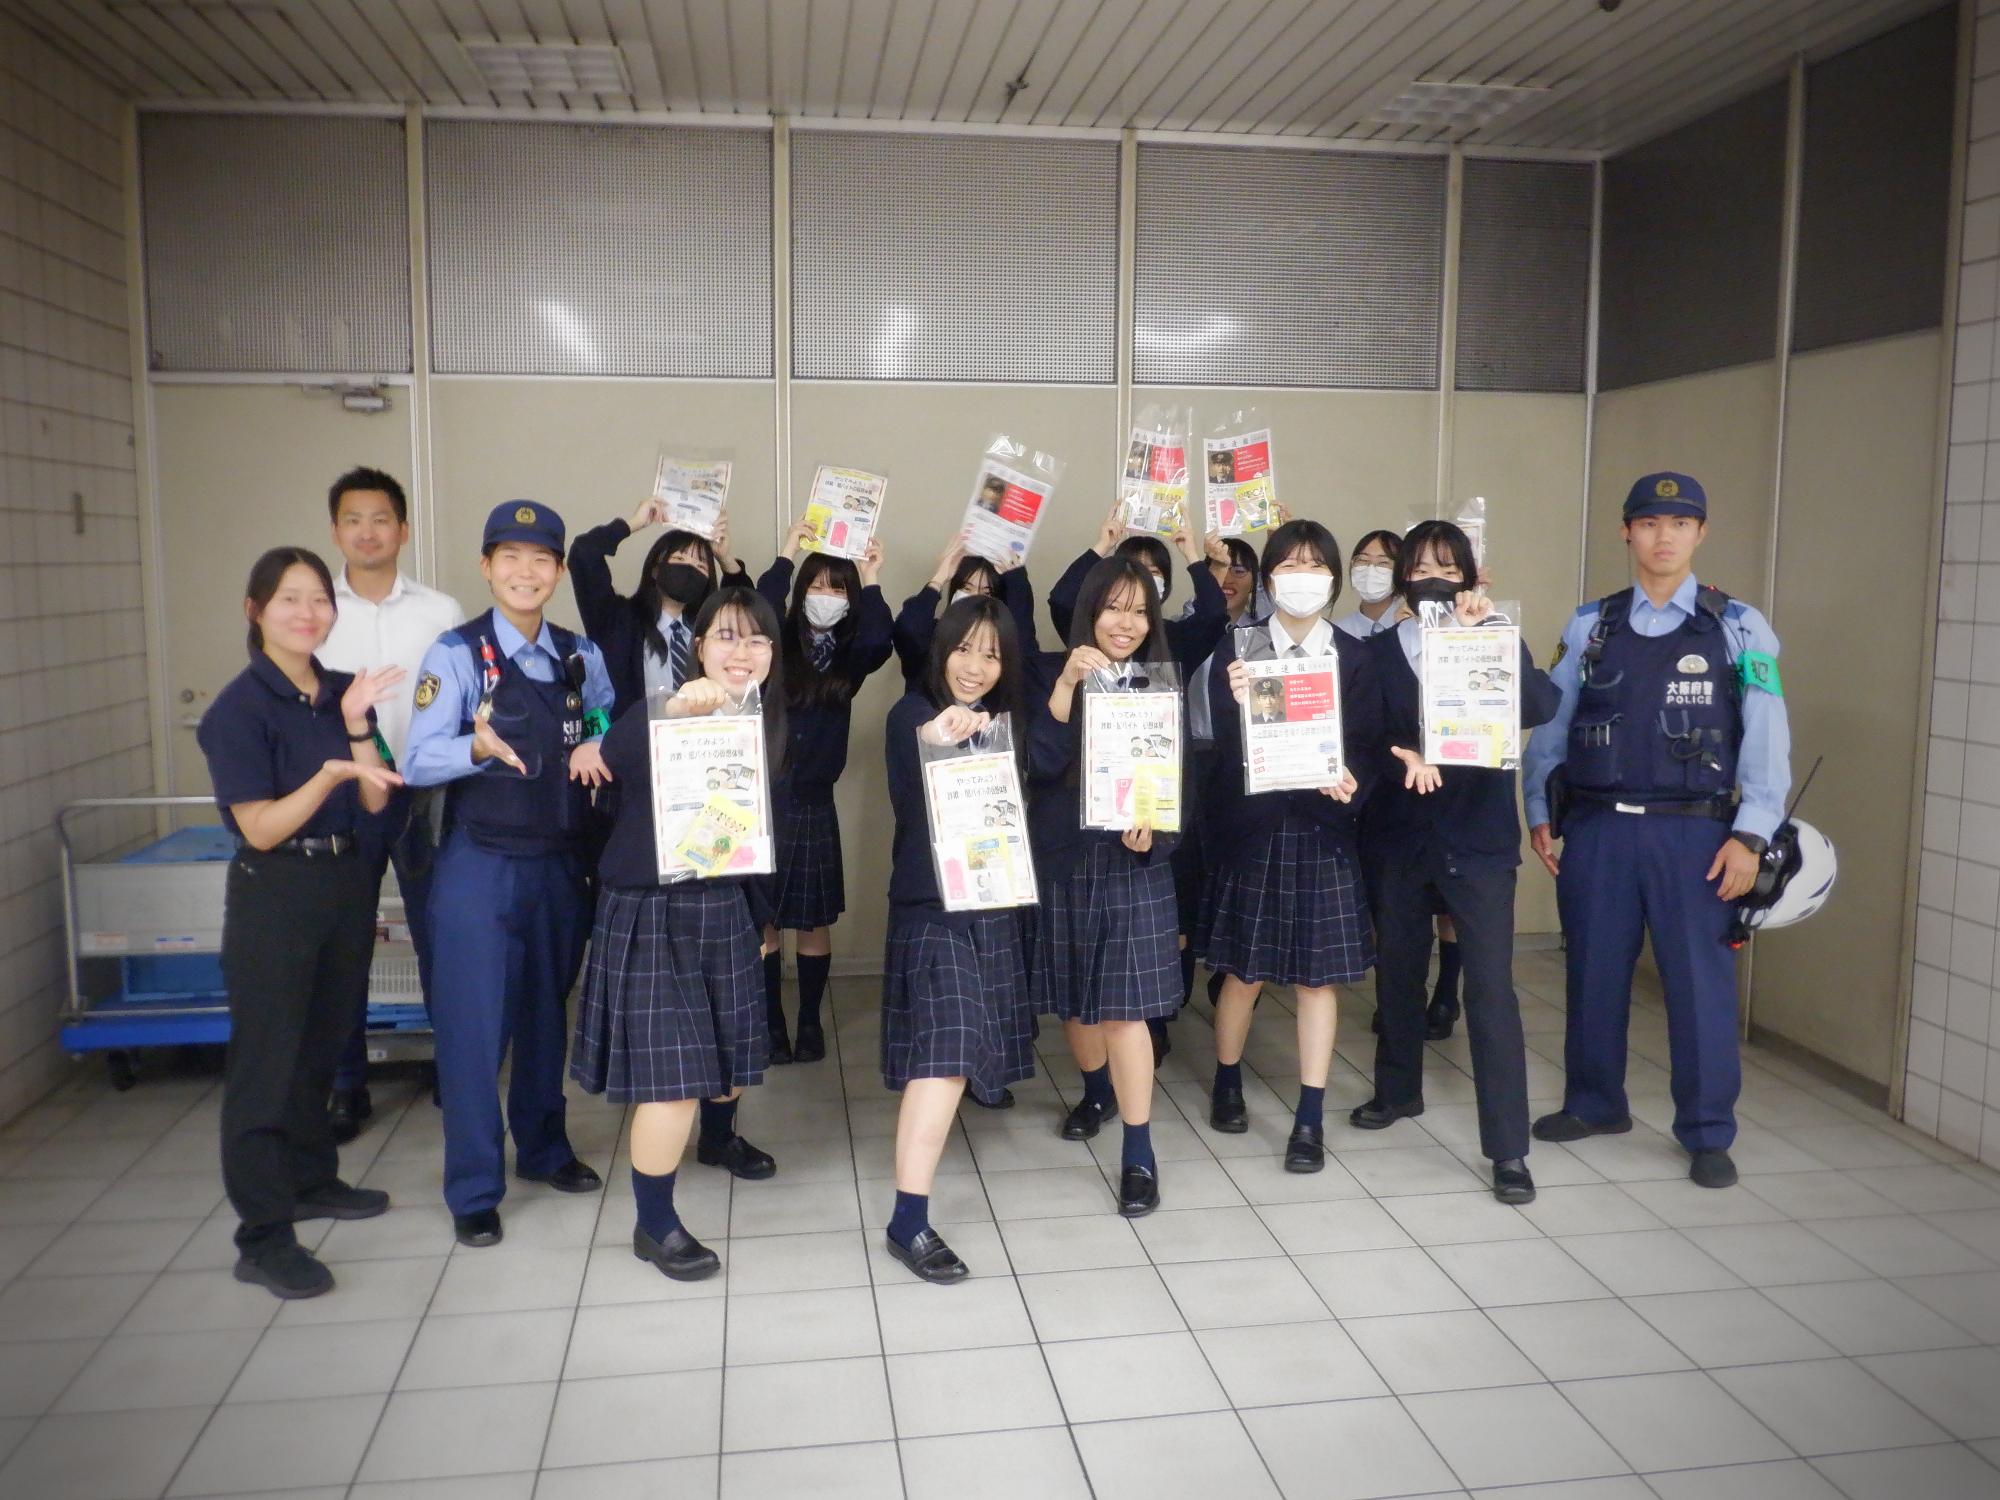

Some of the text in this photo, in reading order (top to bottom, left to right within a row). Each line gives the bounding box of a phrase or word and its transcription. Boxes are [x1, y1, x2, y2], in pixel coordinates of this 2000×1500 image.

[1667, 680, 1714, 695] 大阪府警
[1666, 695, 1713, 705] POLICE
